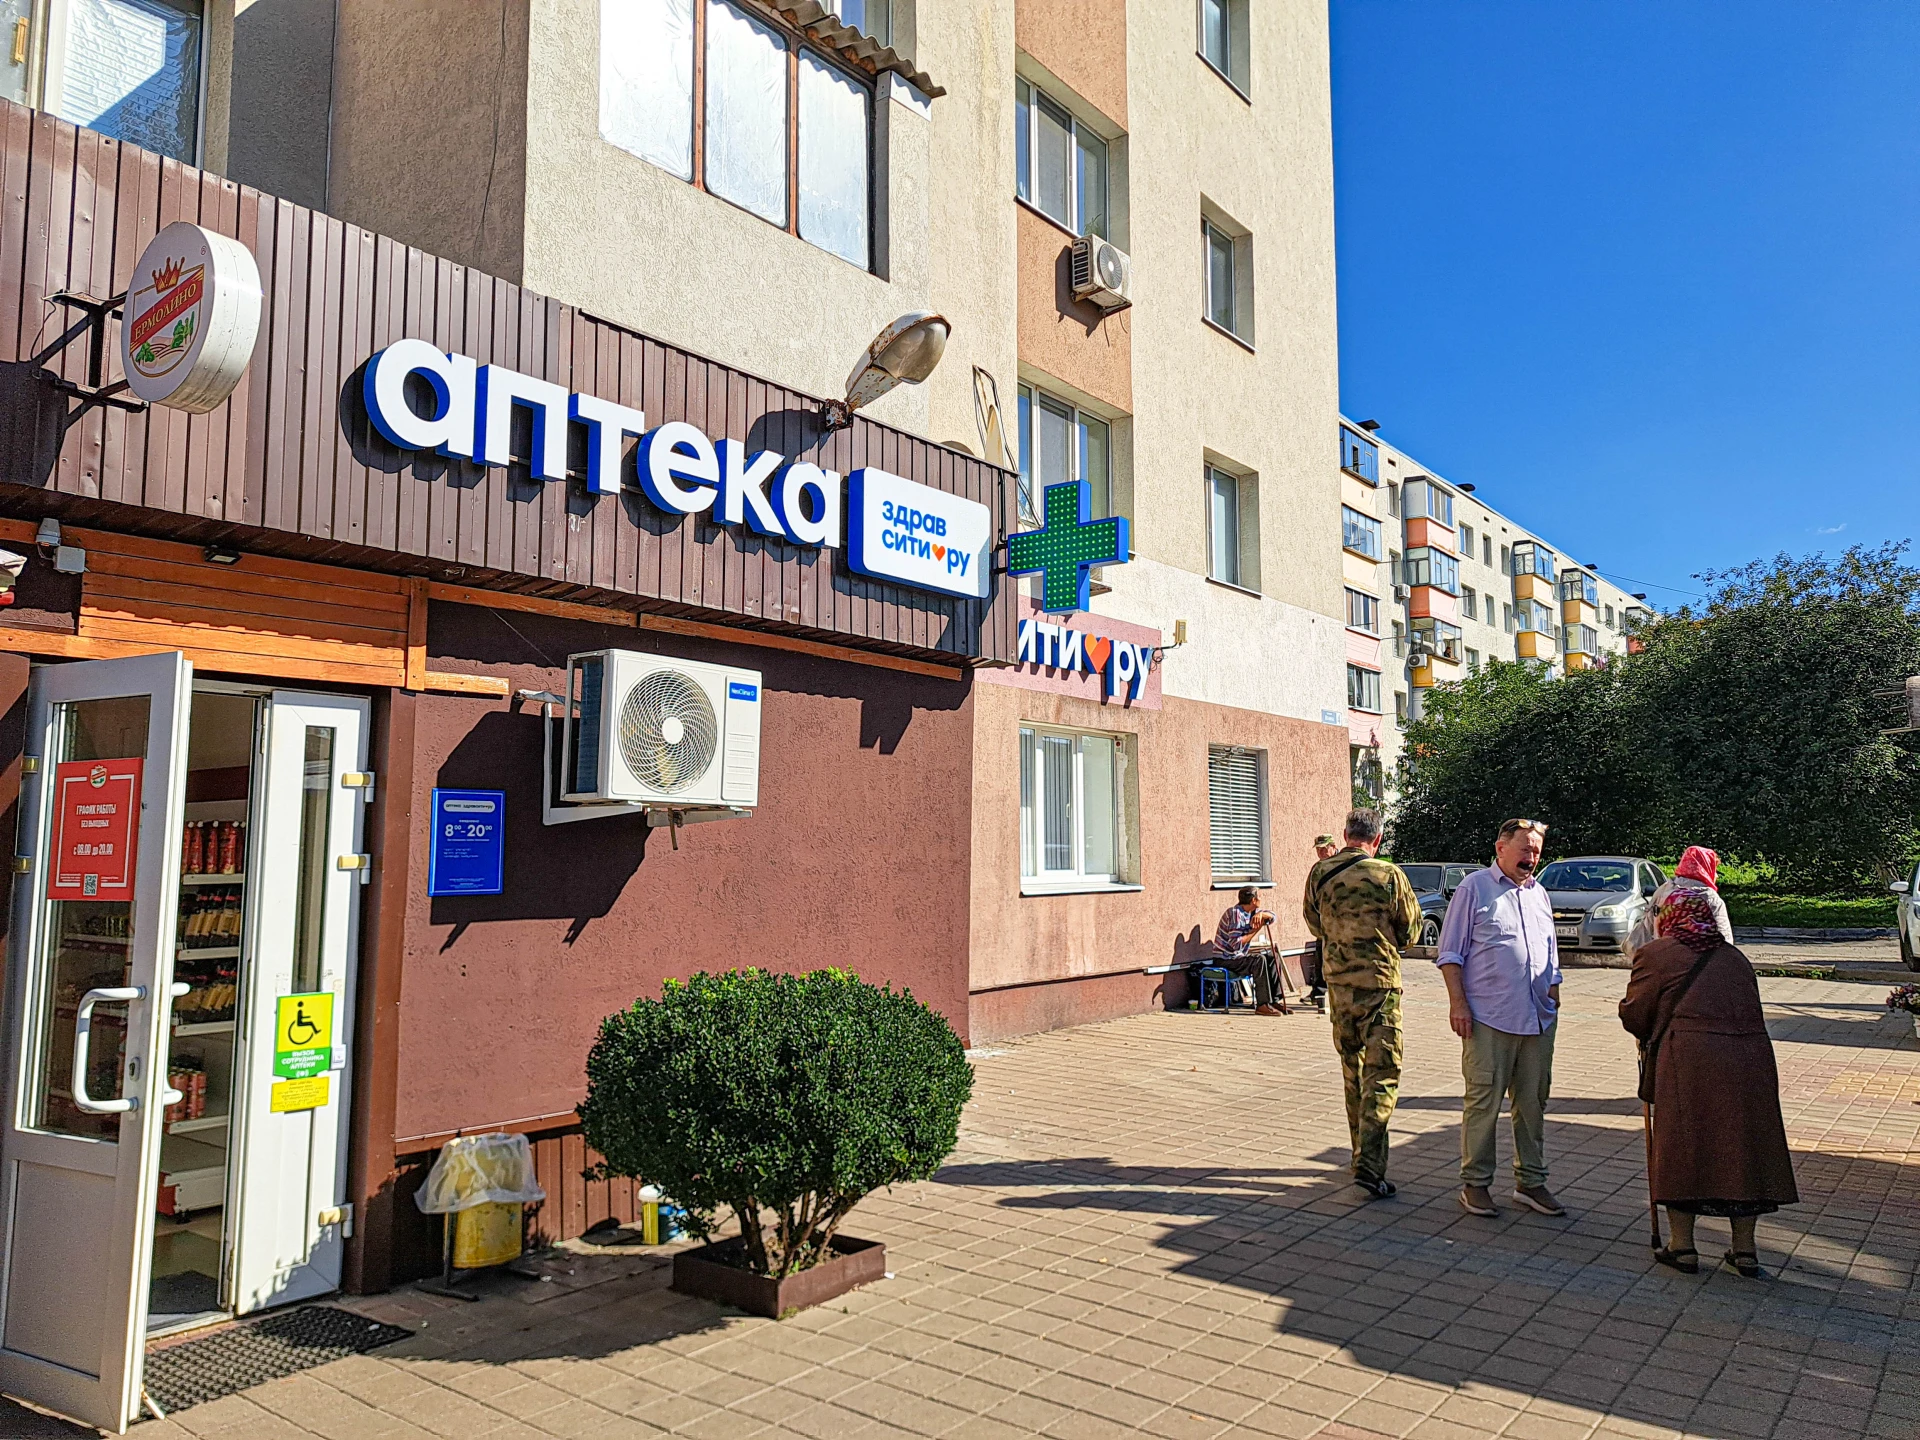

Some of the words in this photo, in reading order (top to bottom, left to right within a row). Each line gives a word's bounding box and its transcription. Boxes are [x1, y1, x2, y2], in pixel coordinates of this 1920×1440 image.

[134, 283, 197, 341] ЕРМОЛИНО
[365, 338, 841, 549] аптека
[882, 500, 947, 537] здрав
[76, 805, 96, 816] ГРАФИК
[97, 803, 117, 814] РАБОТЫ
[281, 1054, 324, 1065] СОТРУДНИКА
[292, 1049, 315, 1058] ВЫЗОВ
[290, 1062, 315, 1070] АПТЕКИ
